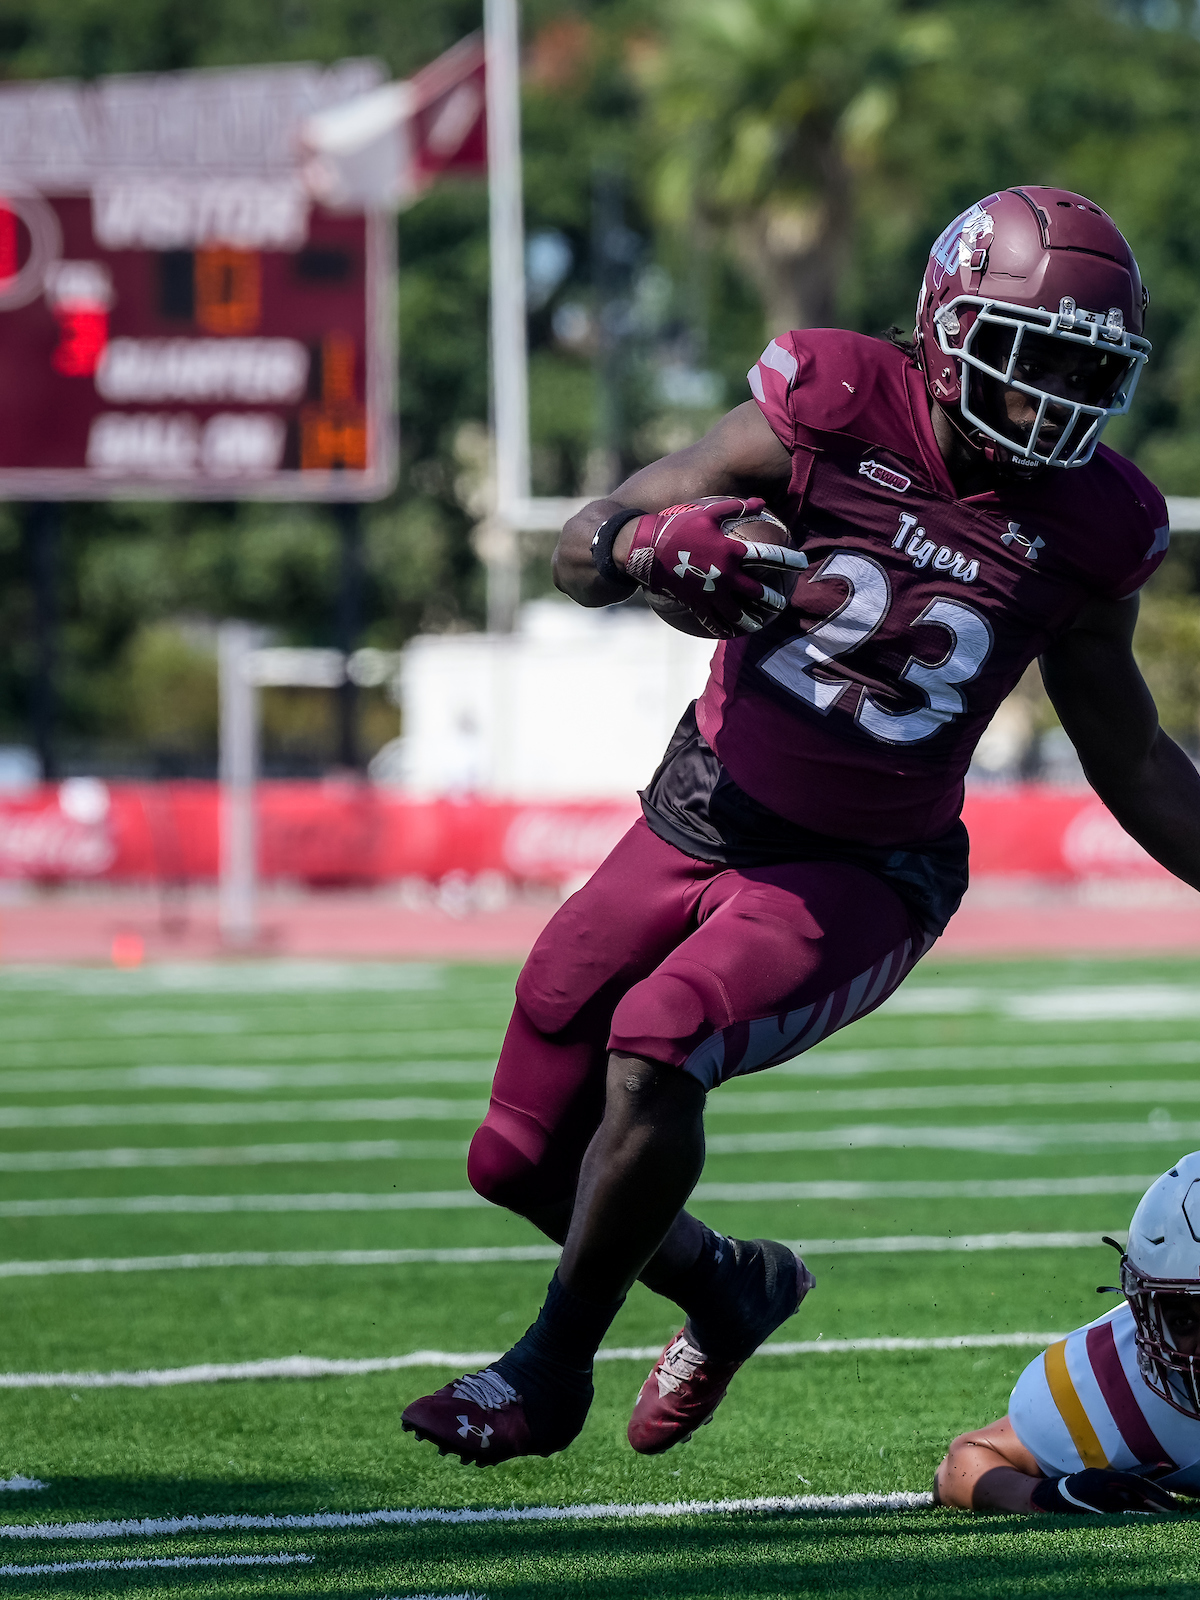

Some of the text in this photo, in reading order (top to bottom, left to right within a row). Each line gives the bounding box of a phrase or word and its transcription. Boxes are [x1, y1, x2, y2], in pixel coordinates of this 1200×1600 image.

[1011, 455, 1039, 467] Riddell
[891, 511, 981, 583] Tigers
[756, 549, 995, 746] 23
